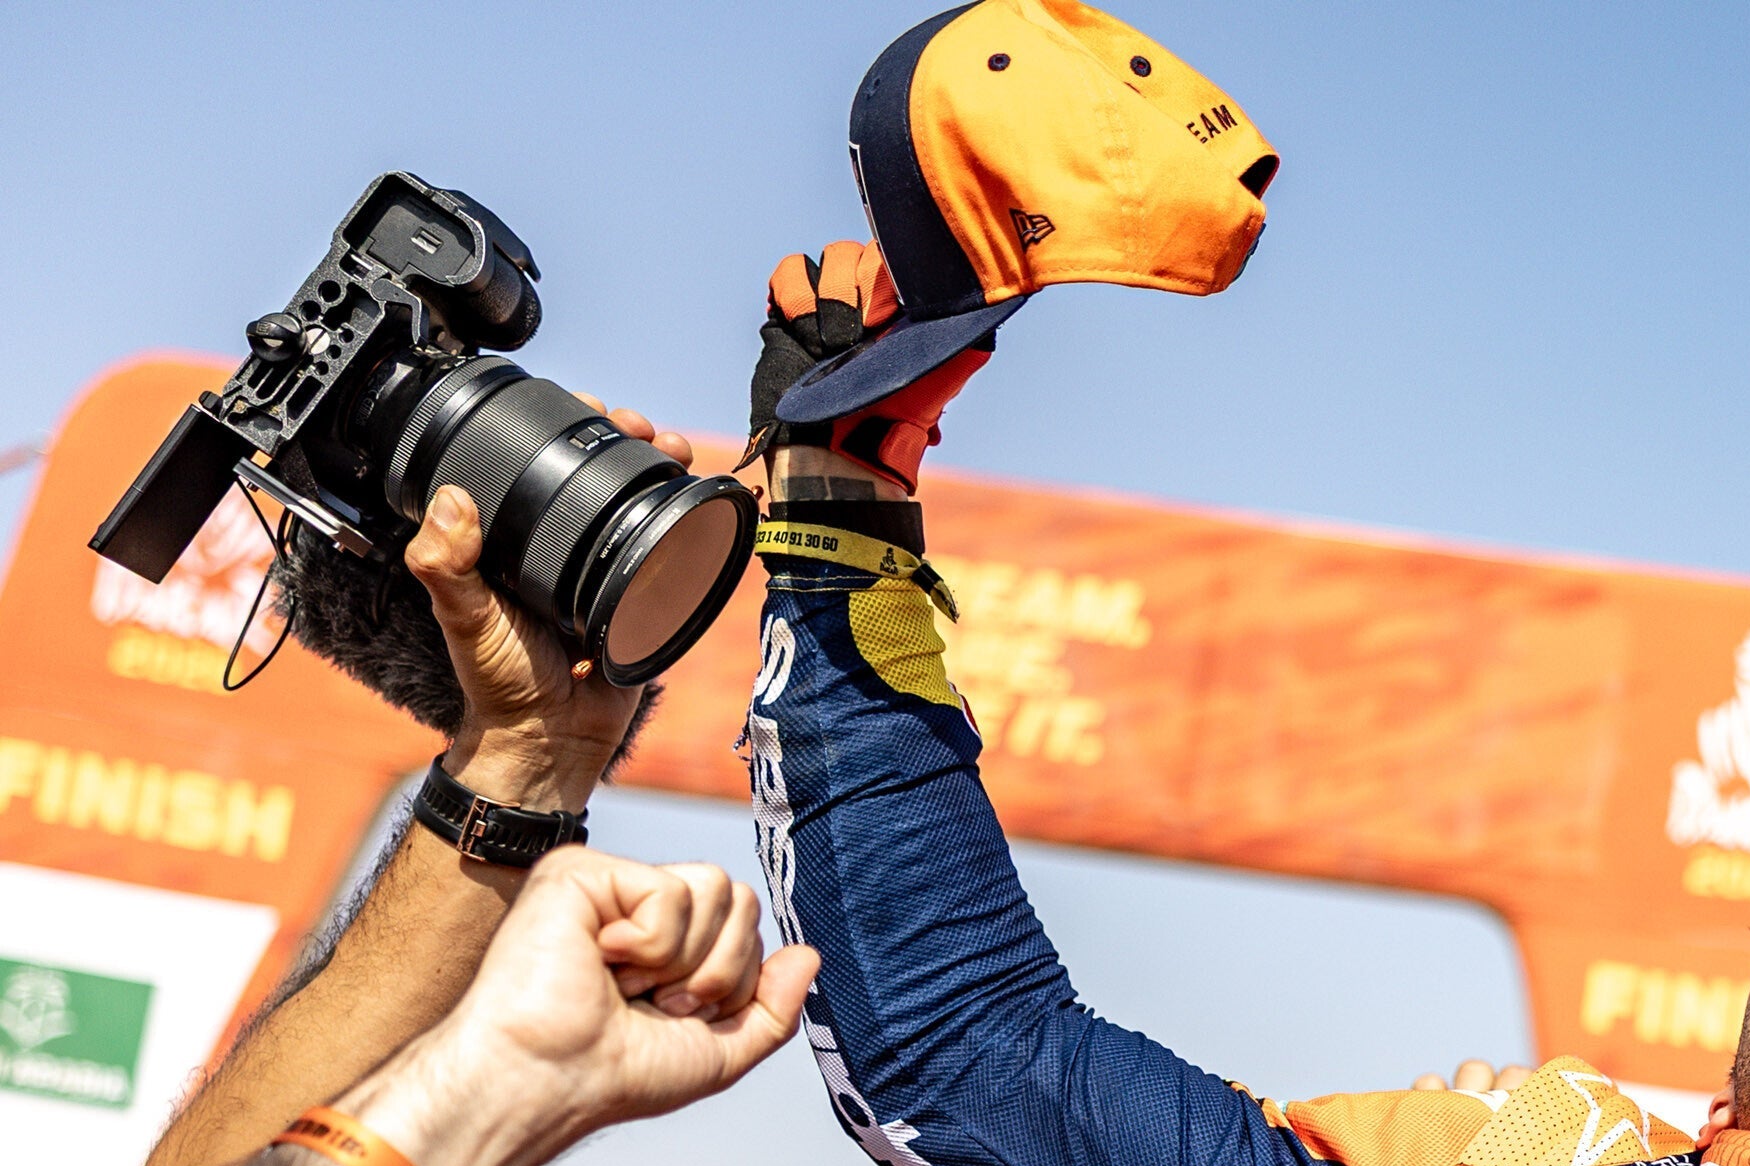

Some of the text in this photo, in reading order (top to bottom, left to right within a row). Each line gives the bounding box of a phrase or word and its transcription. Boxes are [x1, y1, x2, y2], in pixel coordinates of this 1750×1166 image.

[773, 531, 788, 544] 40
[789, 532, 802, 546] 91
[805, 533, 820, 549] 30
[822, 536, 838, 552] 60
[0, 738, 294, 862] FINISH
